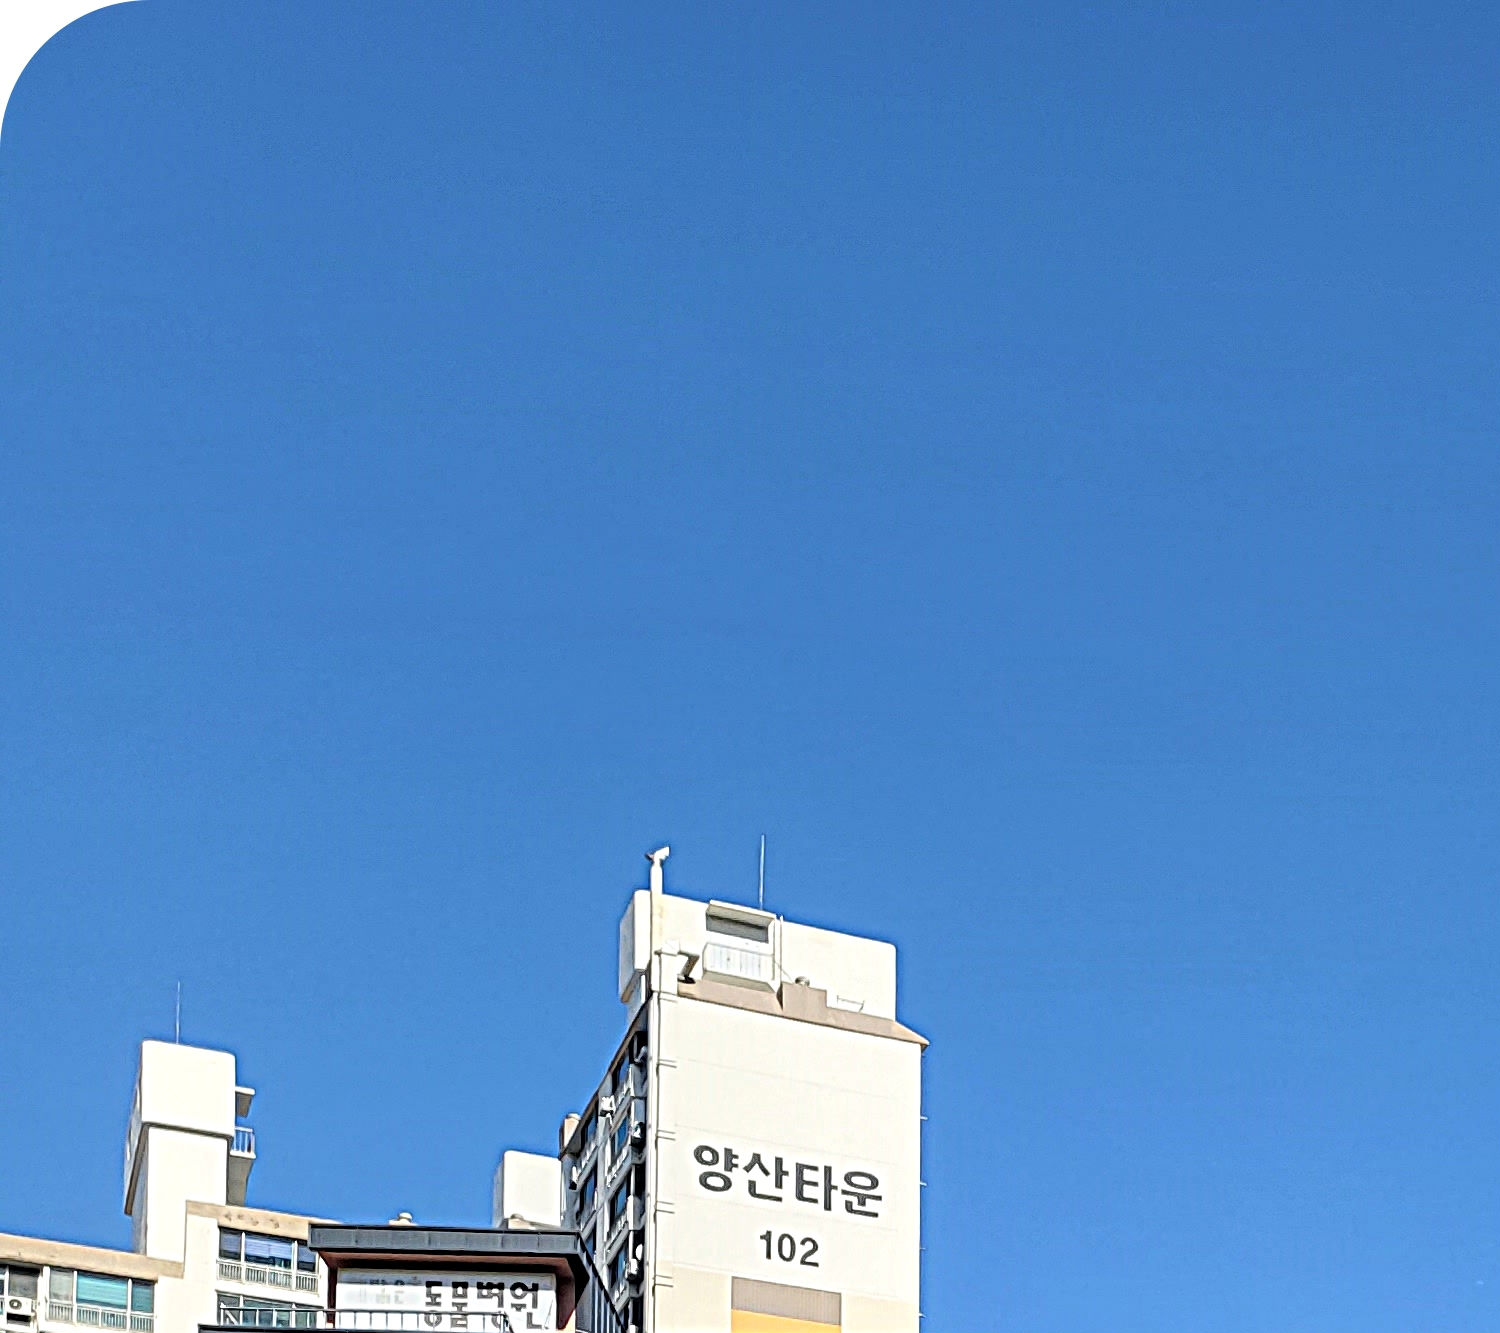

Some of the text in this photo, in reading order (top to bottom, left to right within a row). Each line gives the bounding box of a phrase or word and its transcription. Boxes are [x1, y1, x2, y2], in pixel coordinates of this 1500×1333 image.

[693, 1144, 883, 1218] 양산타운
[759, 1230, 819, 1268] 102
[424, 1280, 543, 1331] 동물병원
